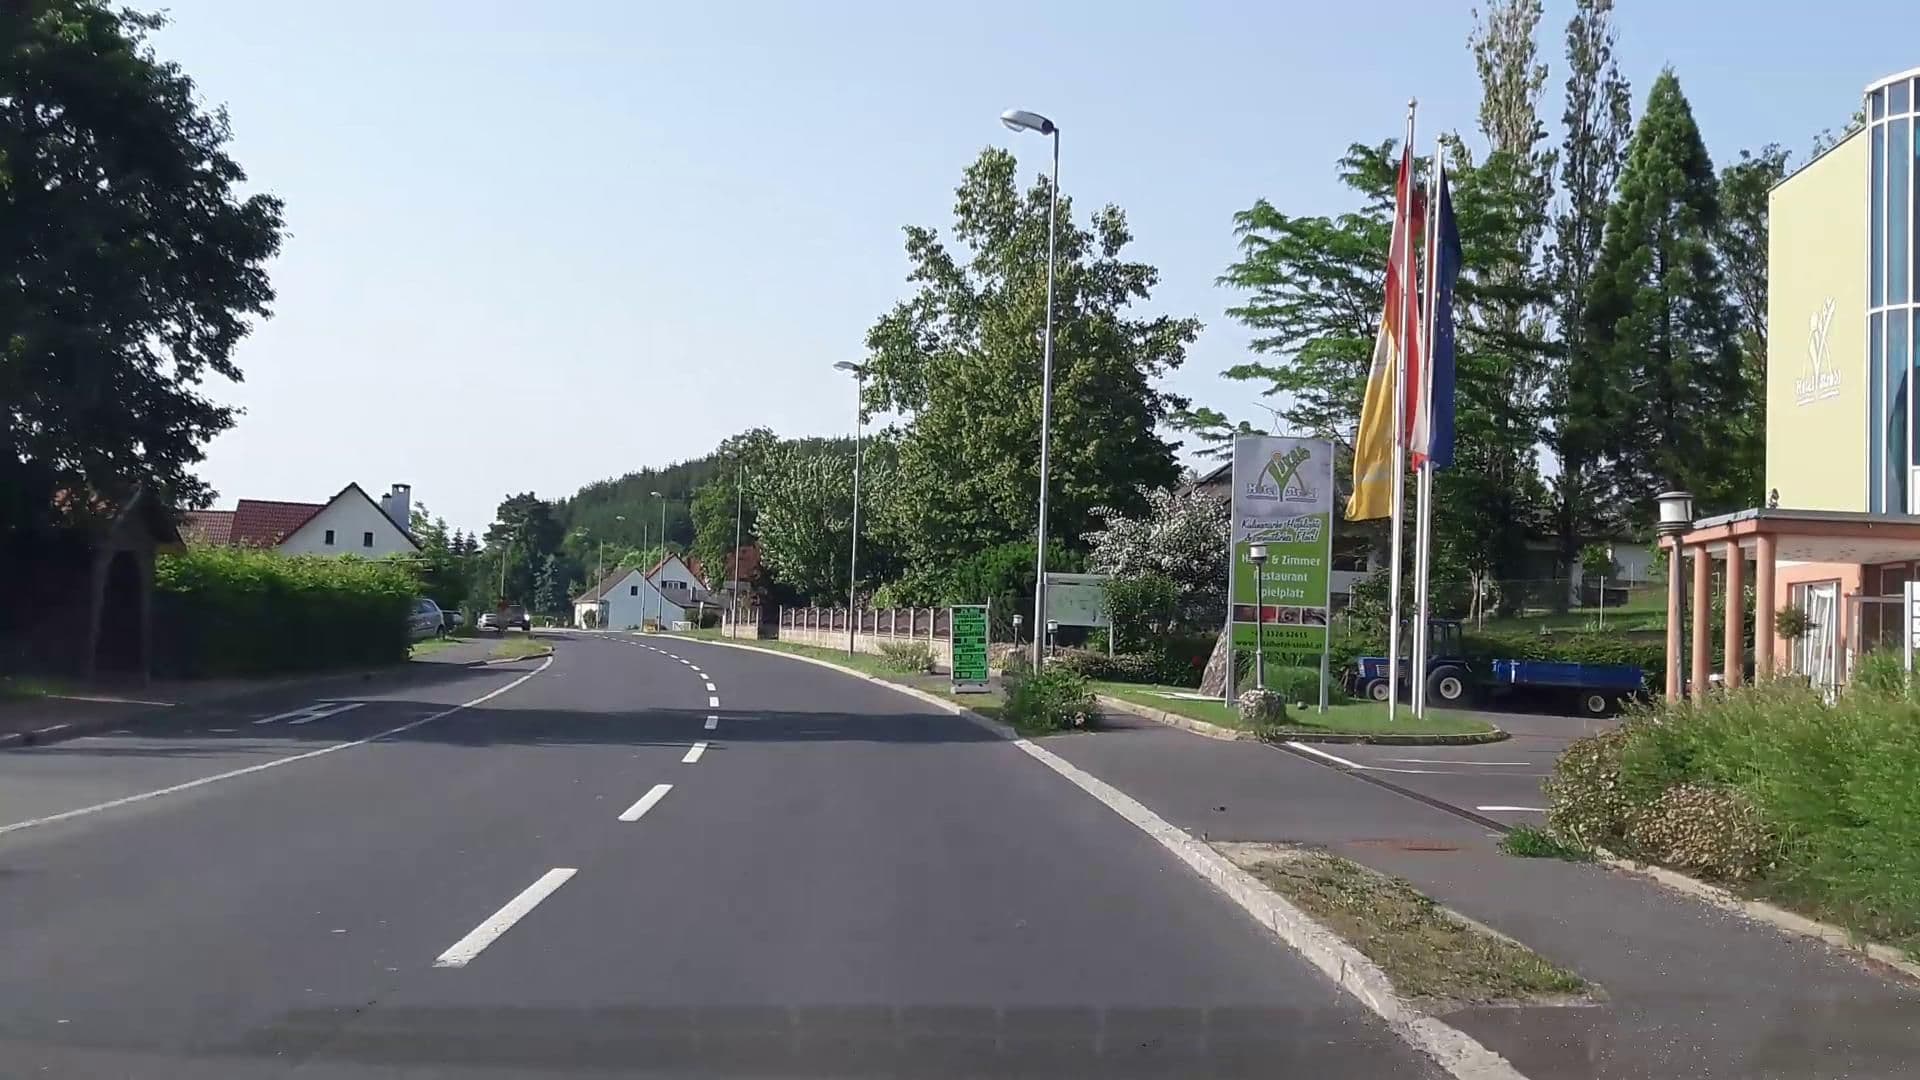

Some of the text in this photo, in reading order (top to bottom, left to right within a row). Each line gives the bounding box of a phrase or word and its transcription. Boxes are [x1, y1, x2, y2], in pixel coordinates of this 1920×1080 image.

[1271, 554, 1279, 565] &
[1281, 554, 1321, 567] Zimmer
[1260, 585, 1305, 600] pielplatz
